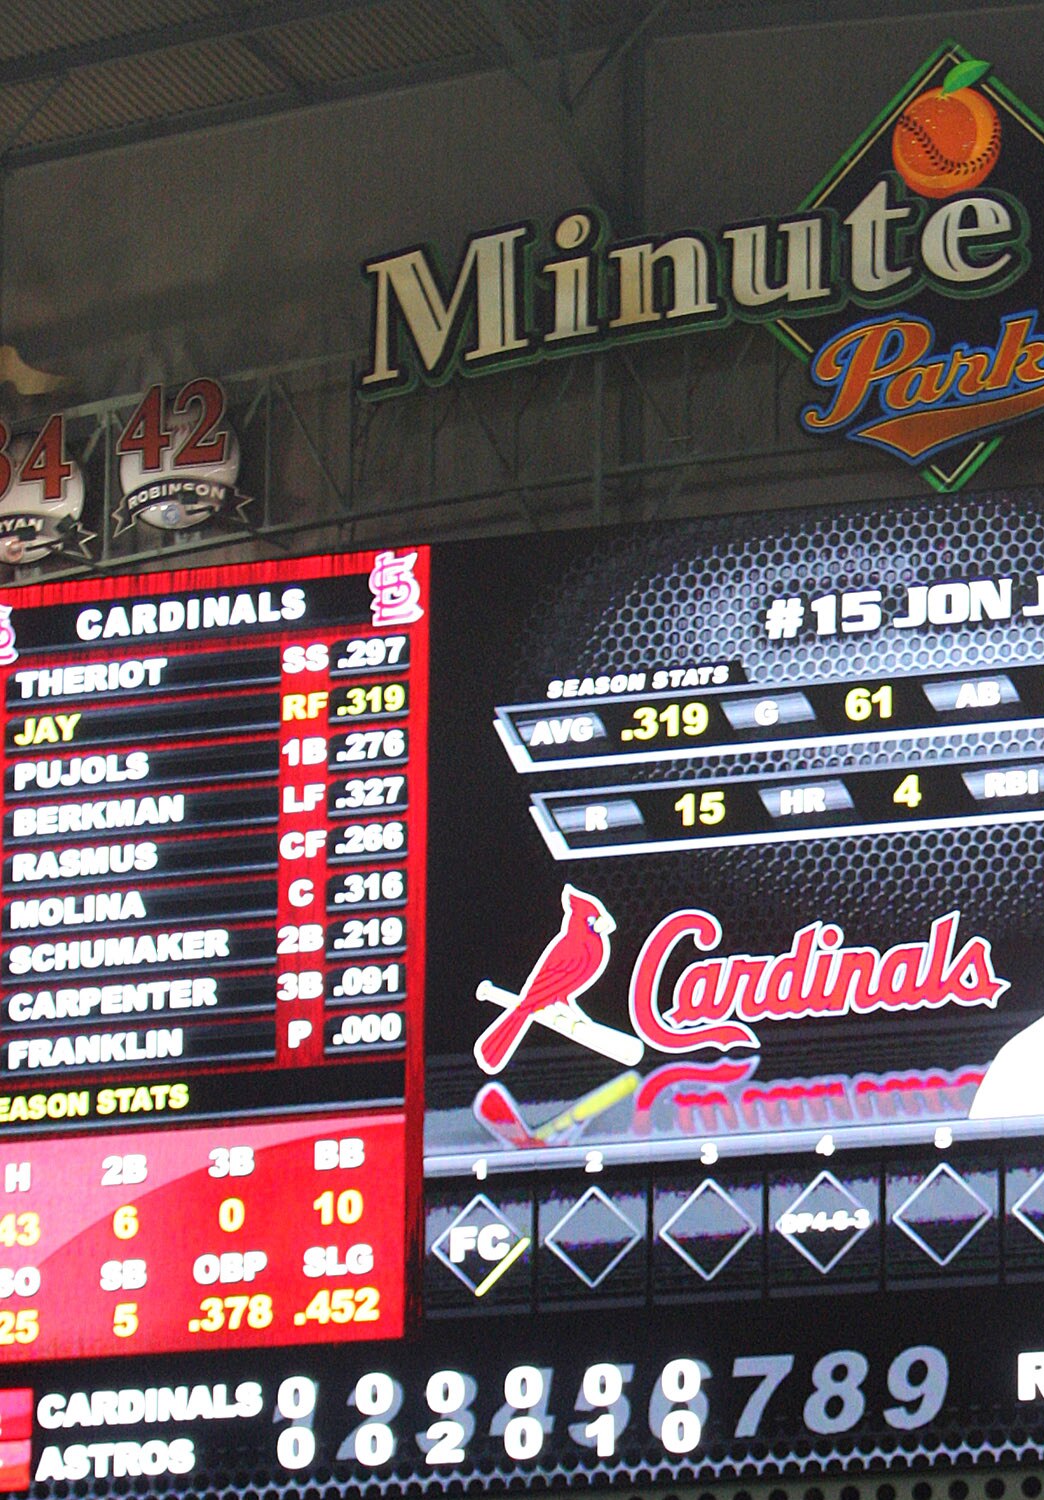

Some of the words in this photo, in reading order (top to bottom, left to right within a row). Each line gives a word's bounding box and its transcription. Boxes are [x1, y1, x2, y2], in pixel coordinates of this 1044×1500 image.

[362, 178, 1014, 387] Minute
[116, 377, 229, 474] 42
[76, 588, 307, 641] CARDINALS
[765, 590, 882, 640] #15
[892, 578, 1013, 629] JON
[15, 657, 168, 699] THERIOT
[282, 643, 330, 674] SS
[337, 636, 406, 669] .297
[547, 672, 646, 699] SEASON
[652, 665, 730, 690] STATS
[14, 713, 82, 746] JAY
[282, 691, 329, 721] RF
[337, 684, 406, 716] .319
[529, 717, 594, 747] AVG
[621, 702, 709, 741] .319
[844, 685, 892, 721] 61
[14, 751, 150, 791] PUJOLS
[281, 737, 328, 767] 1B
[336, 729, 405, 762] .276
[13, 794, 185, 837] BERKMAN
[282, 783, 326, 814] LF
[335, 776, 405, 809] .327
[674, 791, 726, 826] 15
[12, 842, 158, 882] RASMUS
[279, 829, 328, 860] CF
[334, 821, 404, 854] .266
[10, 890, 147, 930] MOLINA
[334, 871, 404, 904] .316
[8, 929, 230, 975] SCHUMAKER
[276, 924, 325, 954] 2B
[333, 917, 403, 950] .219
[8, 977, 218, 1022] CARPENTER
[276, 971, 324, 1001] 3B
[333, 963, 399, 997] .091
[629, 909, 1011, 1054] Cardinals
[8, 1027, 184, 1070] FRANKLIN
[332, 1012, 402, 1045] .000
[96, 1083, 190, 1115] STATS
[100, 1153, 149, 1187] 2B
[208, 1145, 255, 1178] 3B
[314, 1137, 365, 1171] BB
[313, 1189, 364, 1225] 10
[99, 1258, 148, 1291] SB
[193, 1250, 268, 1285] OBP
[302, 1243, 374, 1278] SLG
[188, 1293, 273, 1333] .378
[293, 1286, 380, 1326] .452
[36, 1381, 264, 1429] CARDINALS
[34, 1438, 196, 1482] ASTROS
